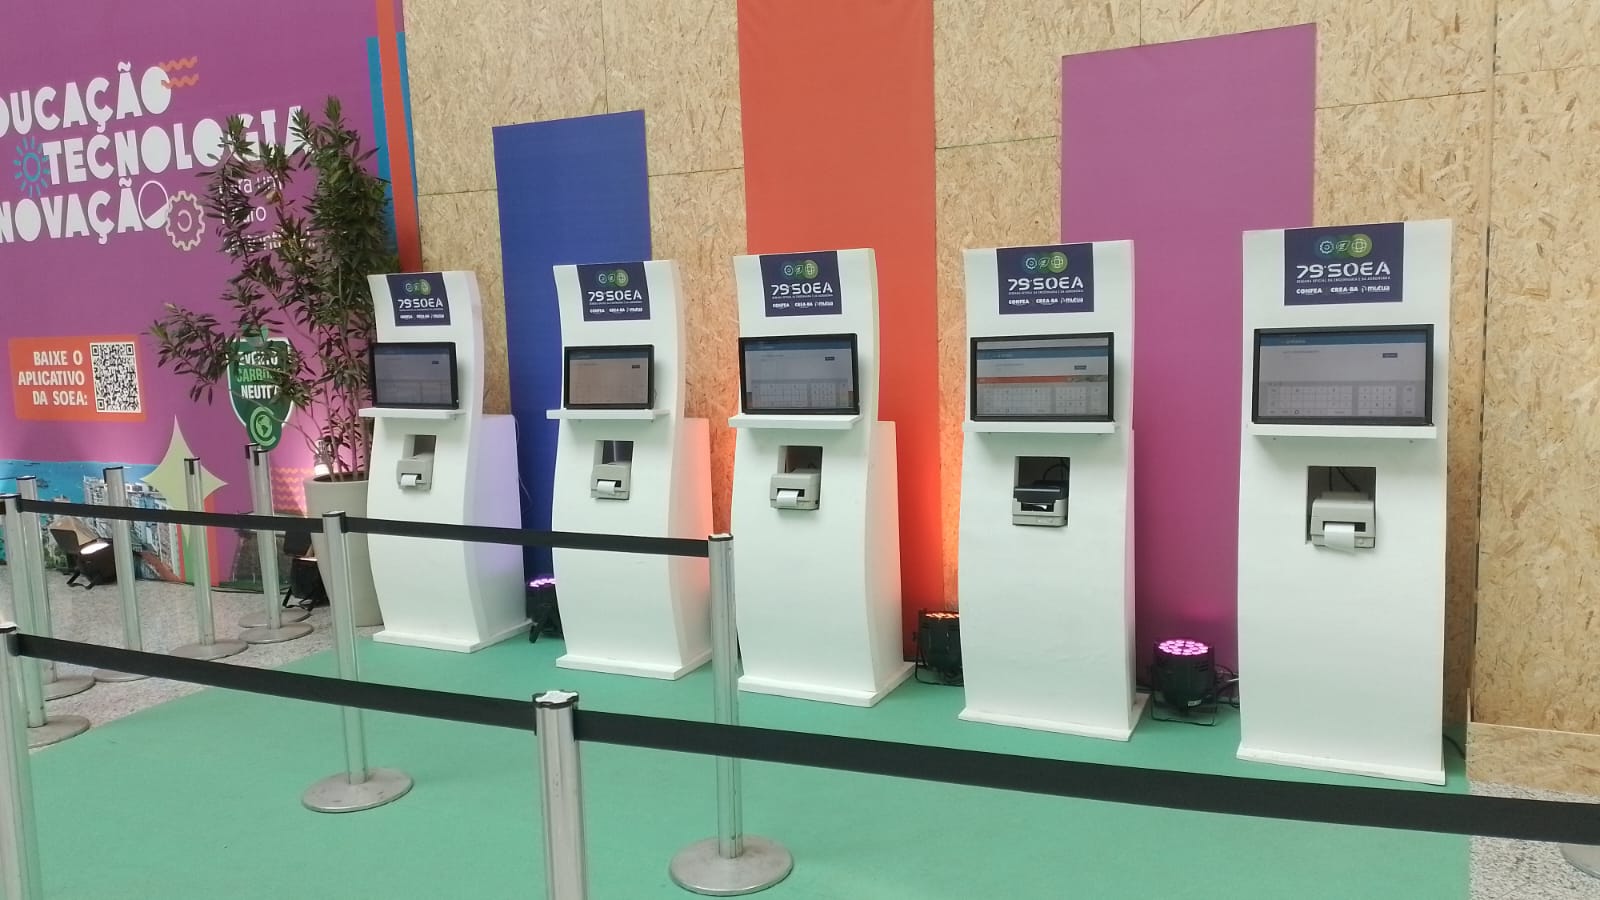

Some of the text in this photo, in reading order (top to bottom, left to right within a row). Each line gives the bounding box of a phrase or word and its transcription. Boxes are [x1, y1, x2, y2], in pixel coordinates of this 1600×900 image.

[33, 350, 83, 367] BAIXE O
[18, 370, 85, 386] APLICATIVO
[33, 389, 88, 406] DA SOEA:
